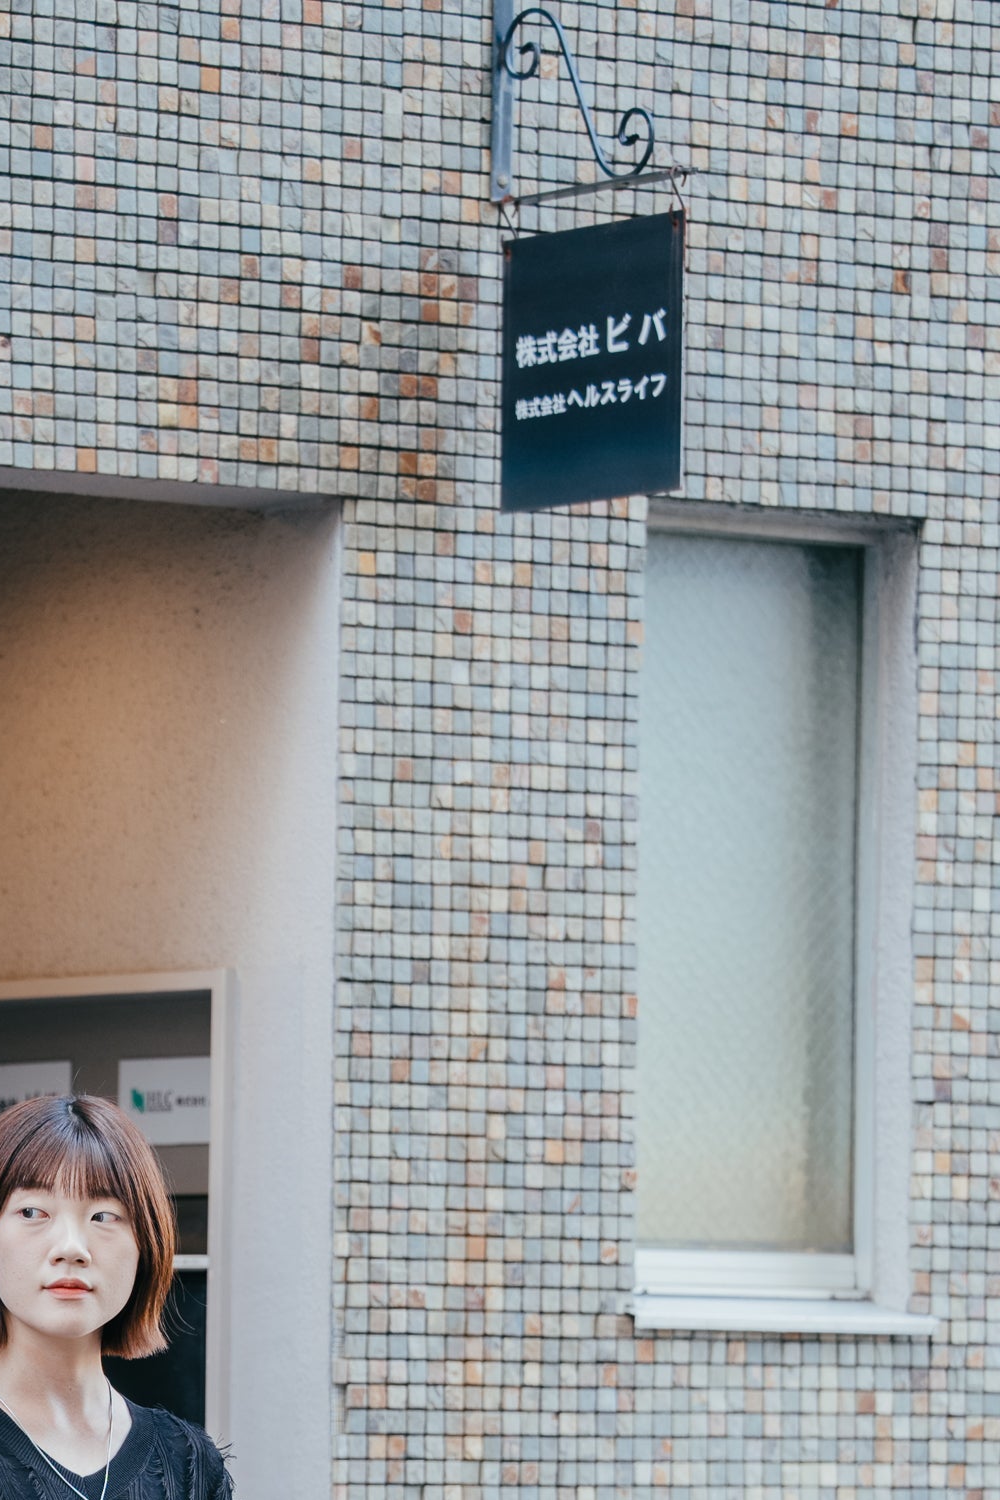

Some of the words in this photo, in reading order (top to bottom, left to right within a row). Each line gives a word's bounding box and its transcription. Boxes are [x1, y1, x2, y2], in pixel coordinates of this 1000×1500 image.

[515, 373, 667, 421] 株式会社ヘルスライフ
